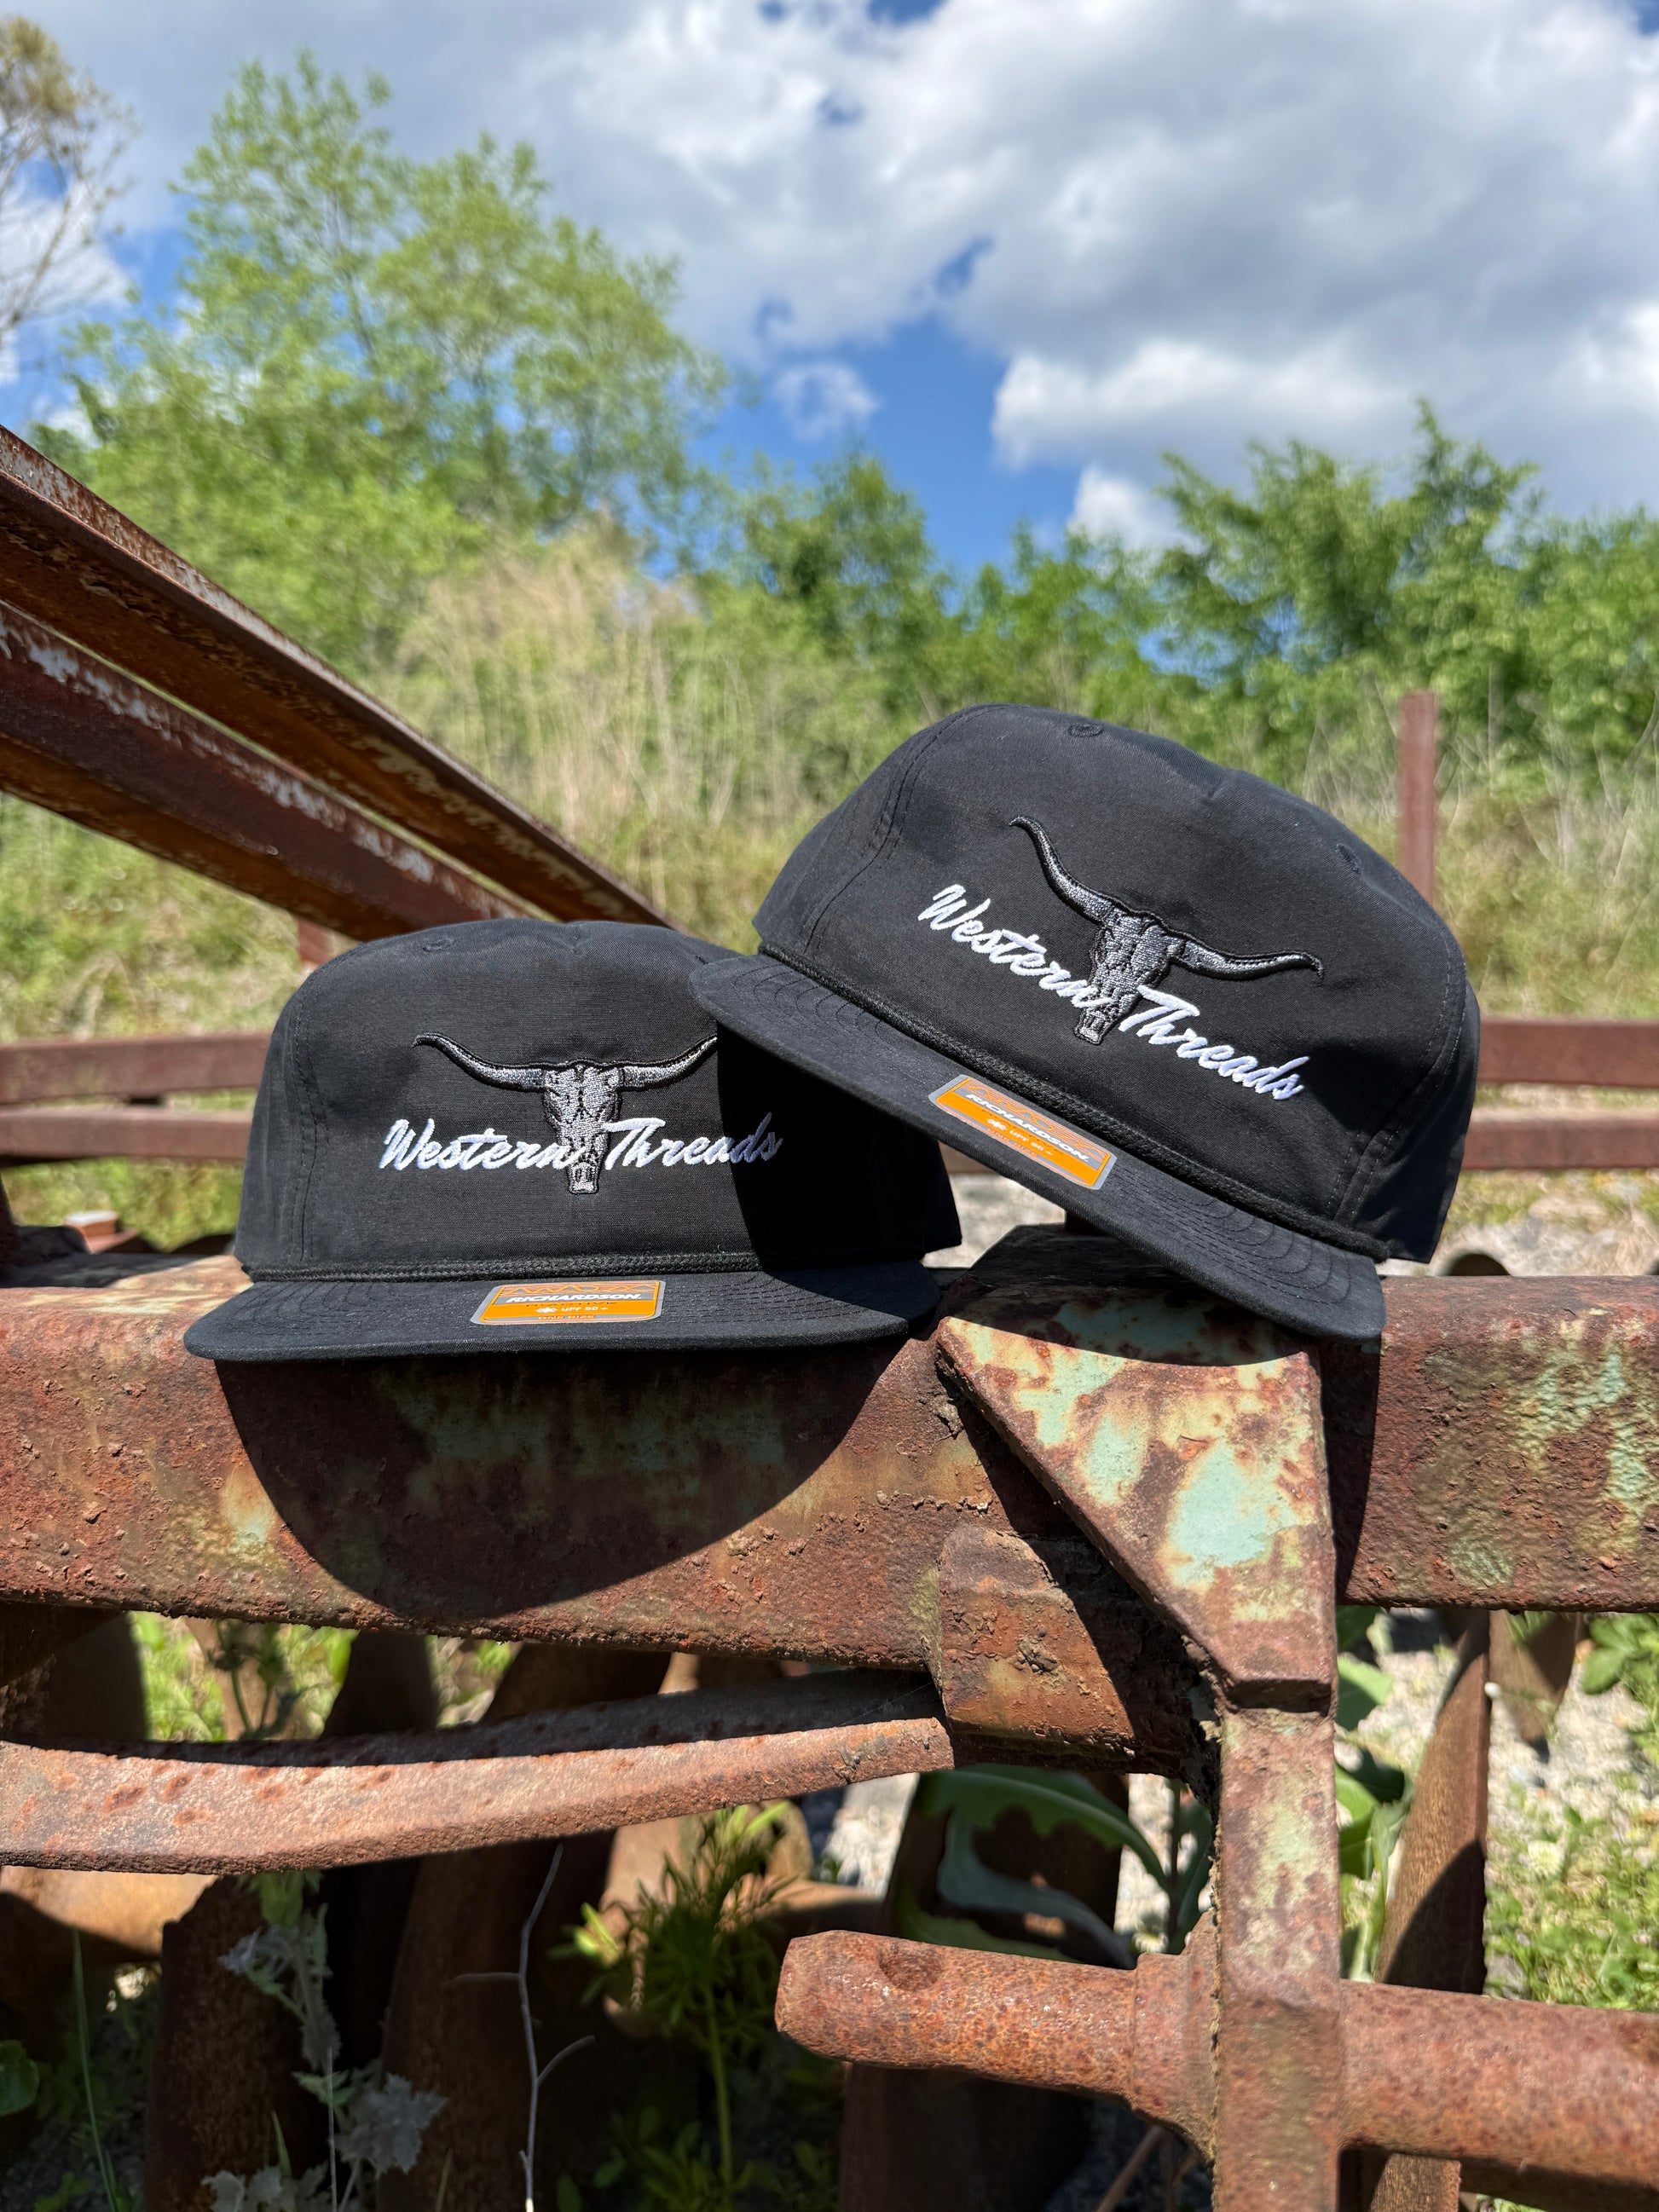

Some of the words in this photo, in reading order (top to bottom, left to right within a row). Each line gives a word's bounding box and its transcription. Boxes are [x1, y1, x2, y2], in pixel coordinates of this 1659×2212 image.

[918, 884, 1115, 1008] Western
[1119, 985, 1309, 1100] Threads
[379, 1118, 582, 1170] Western
[602, 1112, 783, 1170] Threads
